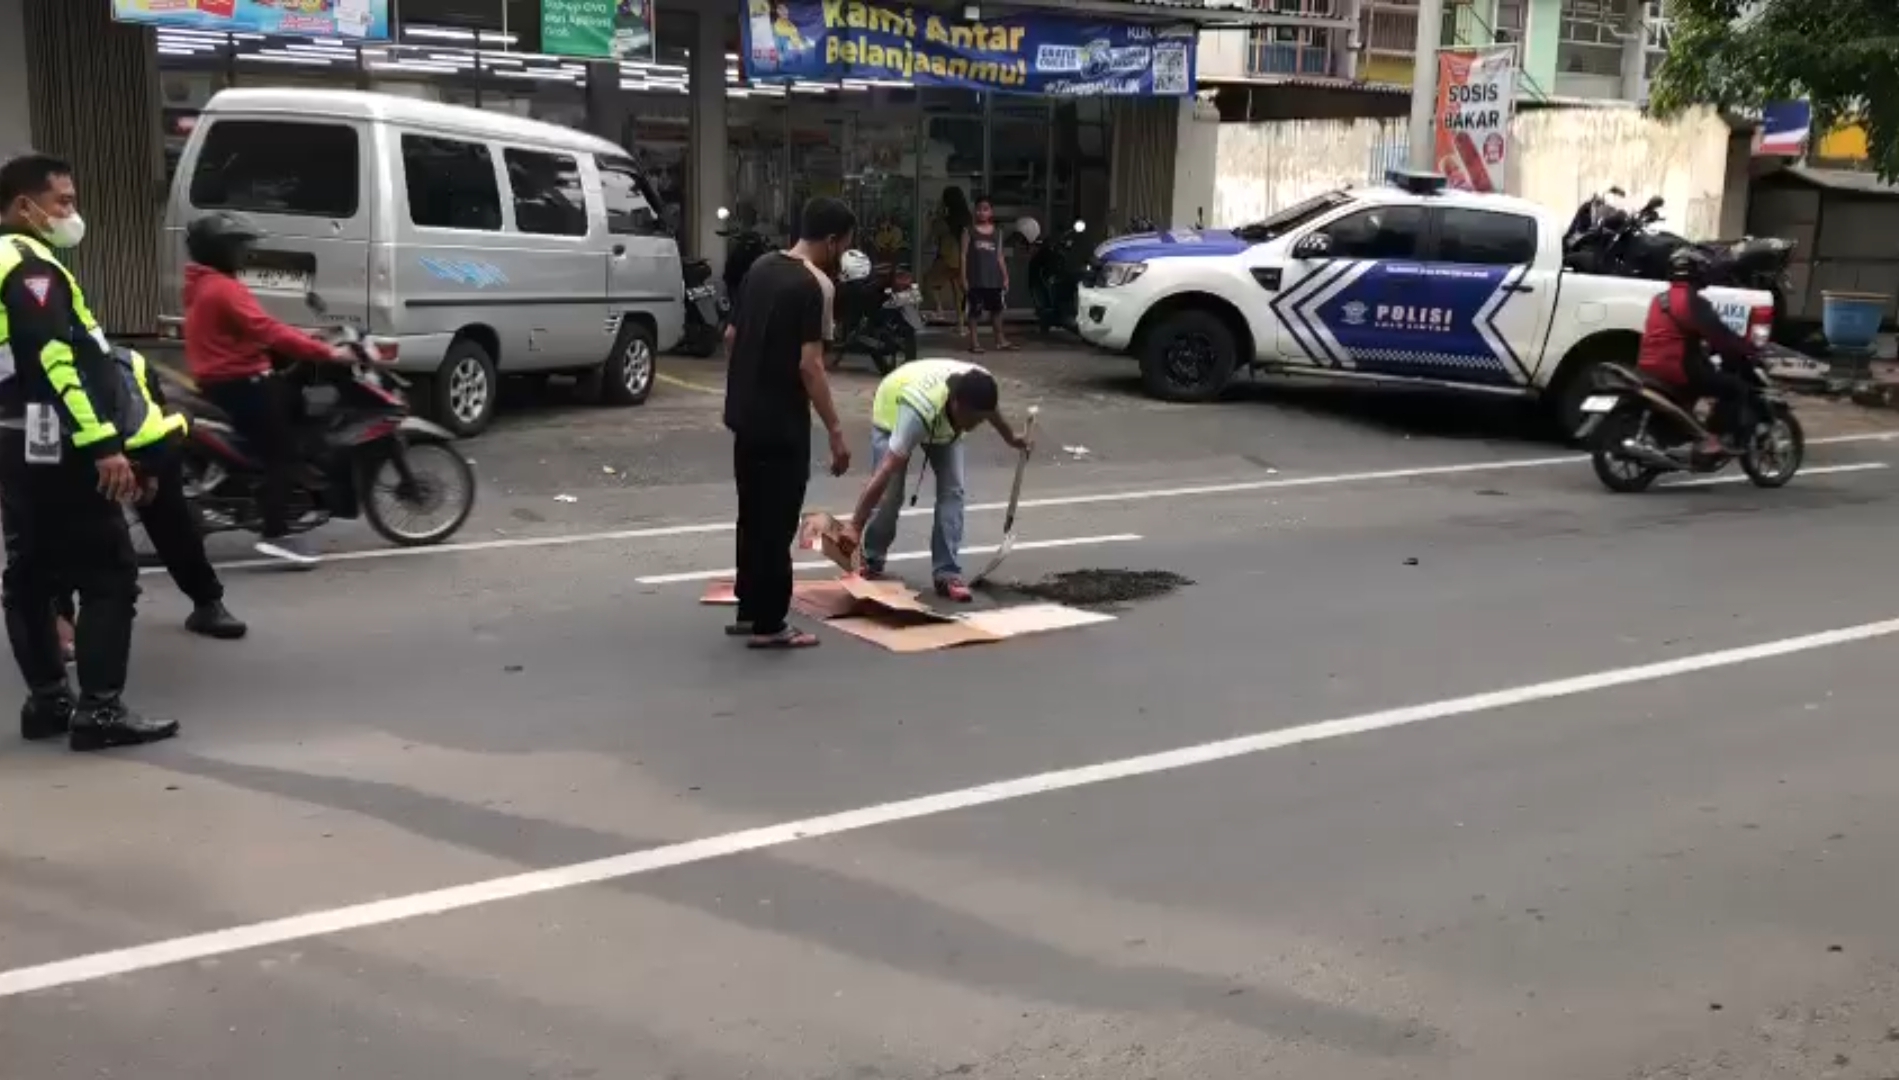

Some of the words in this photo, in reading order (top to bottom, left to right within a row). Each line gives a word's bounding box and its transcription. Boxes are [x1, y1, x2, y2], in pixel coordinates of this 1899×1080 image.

[823, 0, 916, 37] Kami
[926, 14, 1025, 53] Antar
[826, 35, 1027, 85] Belanjaanmu!
[1448, 83, 1498, 102] SOSIS
[1444, 110, 1500, 129] BAKAR
[1376, 304, 1452, 325] POLISI
